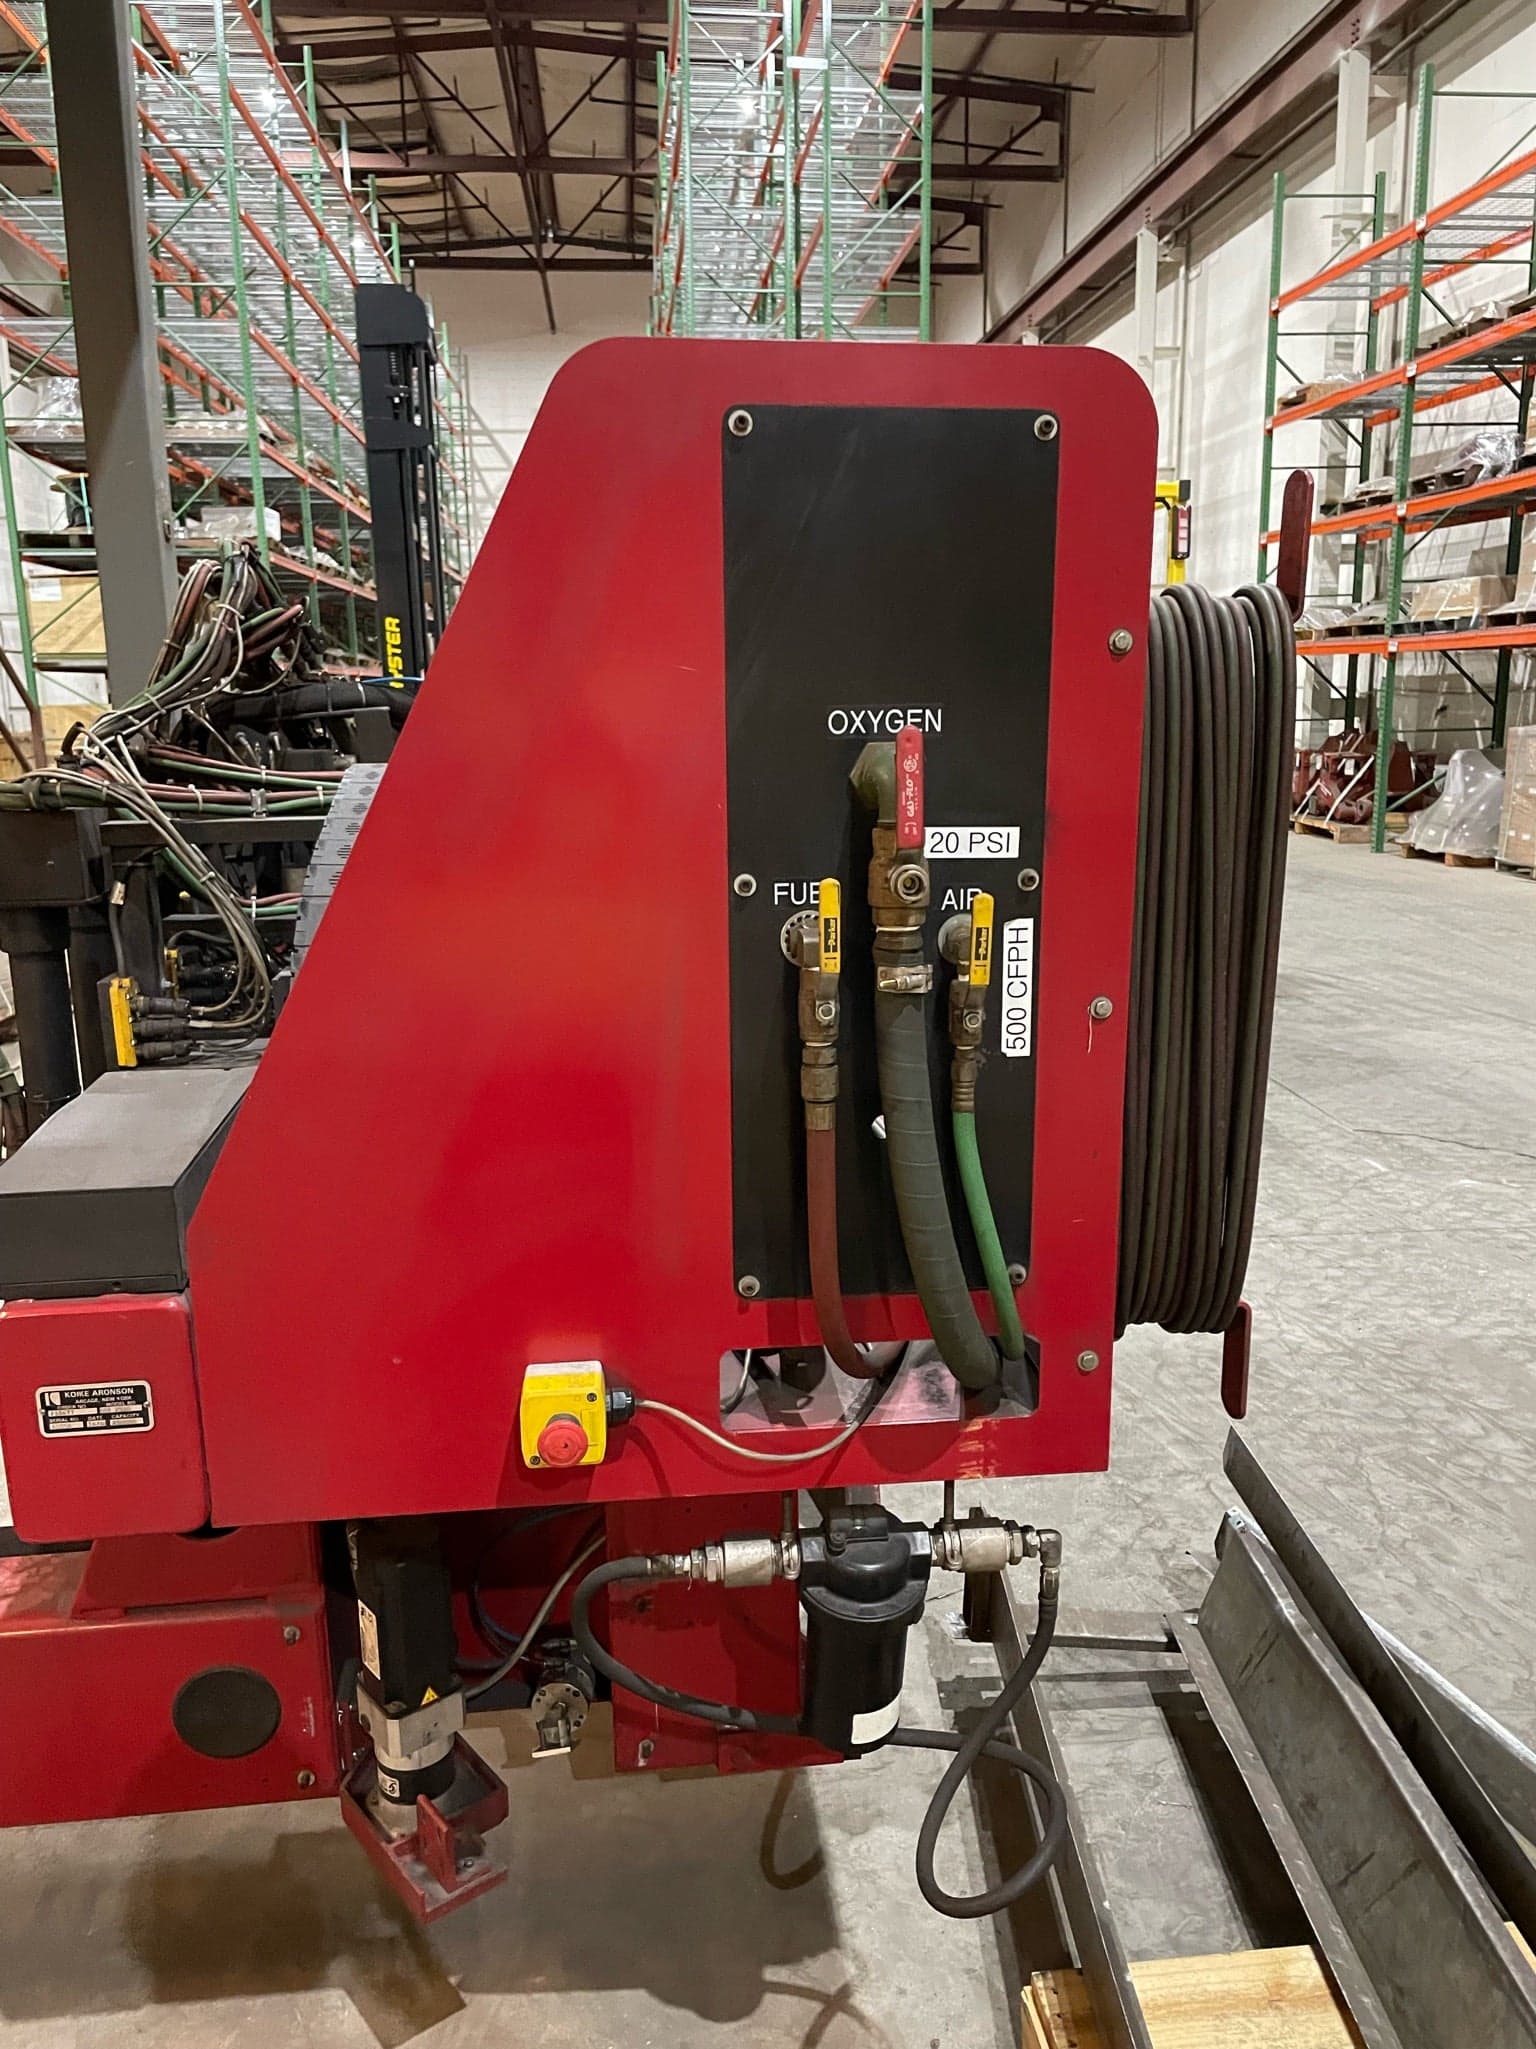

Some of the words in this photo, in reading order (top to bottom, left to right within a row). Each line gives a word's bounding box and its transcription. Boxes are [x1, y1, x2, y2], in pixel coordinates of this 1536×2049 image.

[828, 708, 942, 735] OXYGEN
[929, 832, 960, 854] 20
[968, 831, 1011, 853] PSI
[774, 881, 820, 905] FUE
[941, 887, 983, 911] AIR
[1006, 927, 1029, 999] CFPH
[1006, 1007, 1027, 1050] 500
[64, 1390, 90, 1398] KOIKE
[92, 1387, 134, 1397] ARONSON
